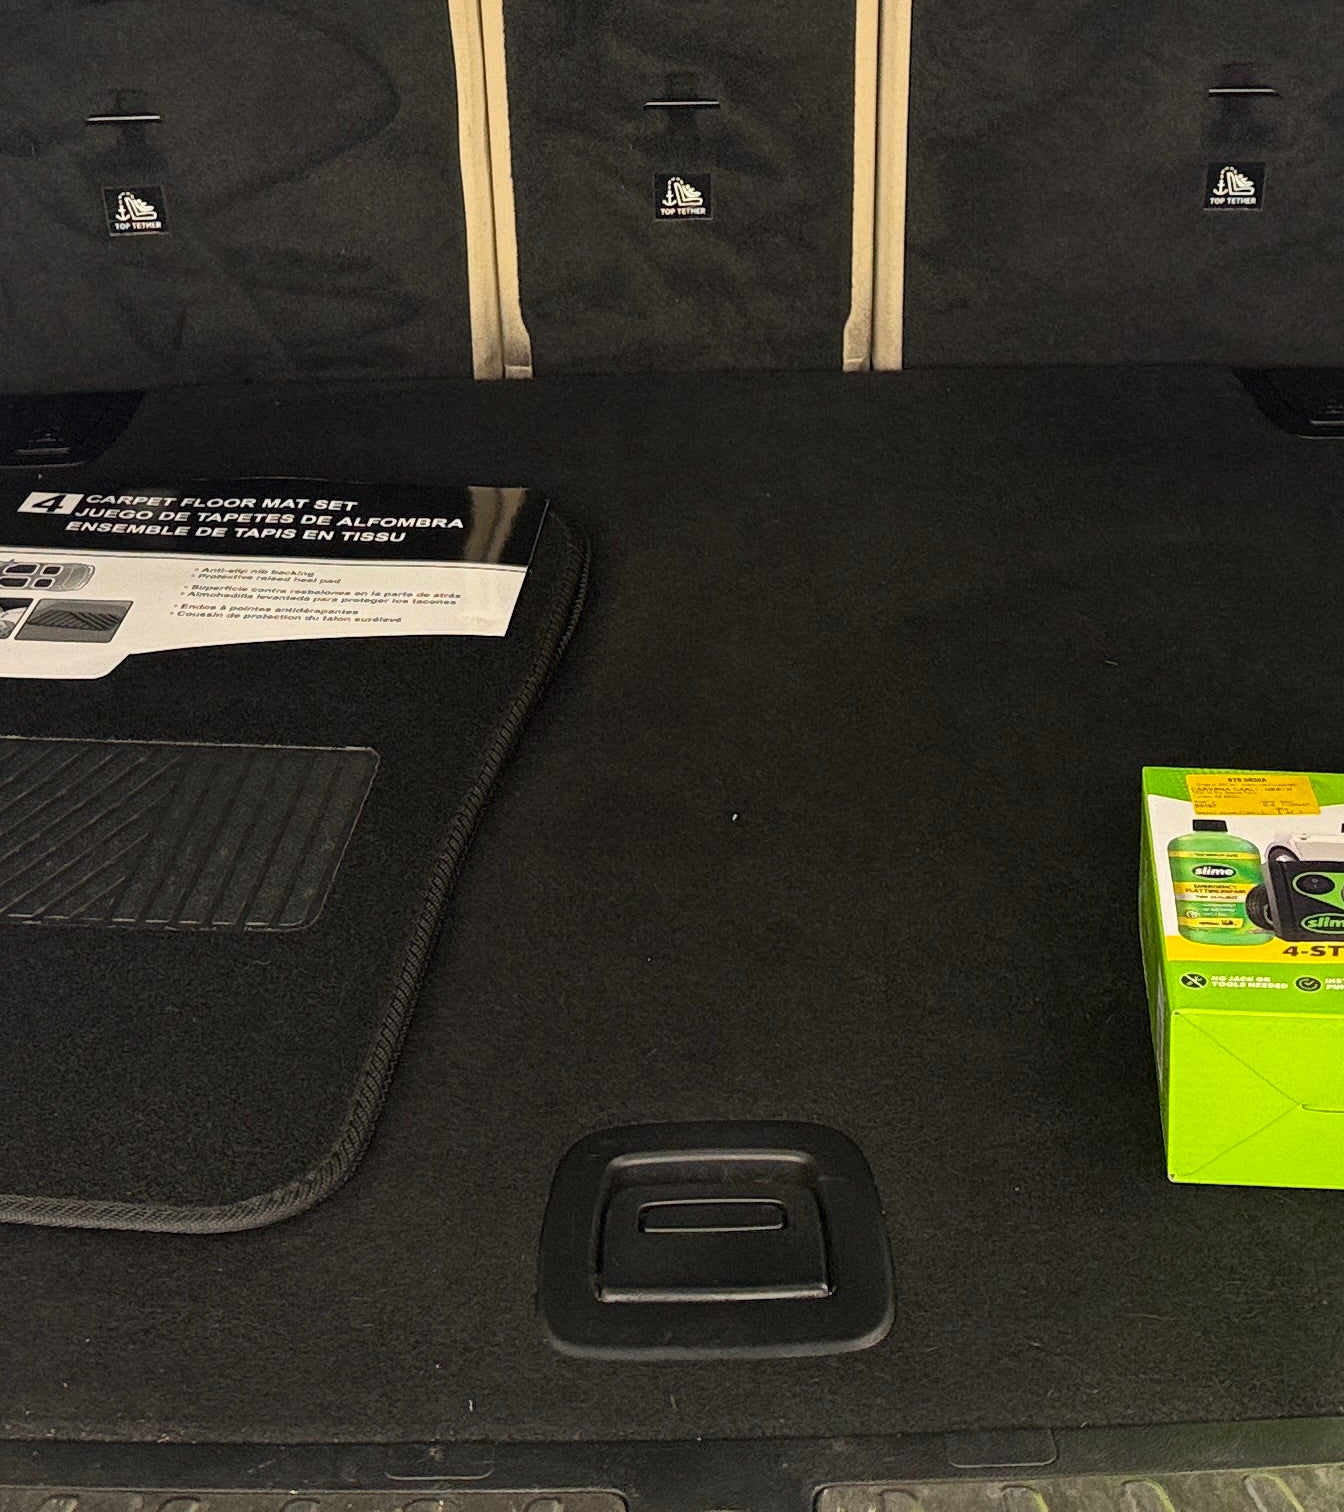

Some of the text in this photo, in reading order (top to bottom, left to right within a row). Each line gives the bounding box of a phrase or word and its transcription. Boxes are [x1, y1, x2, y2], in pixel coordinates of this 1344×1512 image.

[1210, 197, 1257, 205] TOP TETHER
[660, 207, 706, 216] TOP TETHER
[132, 221, 162, 229] TETHER
[32, 494, 66, 513] 4
[86, 494, 359, 511] CARPET FLOOR MAT SET
[74, 507, 464, 529] JUEGO DE TAPETES DE ALFOMBRA
[65, 521, 407, 543] ENSEMBLE DE TAPIS EN TISSU
[1194, 866, 1234, 876] slime
